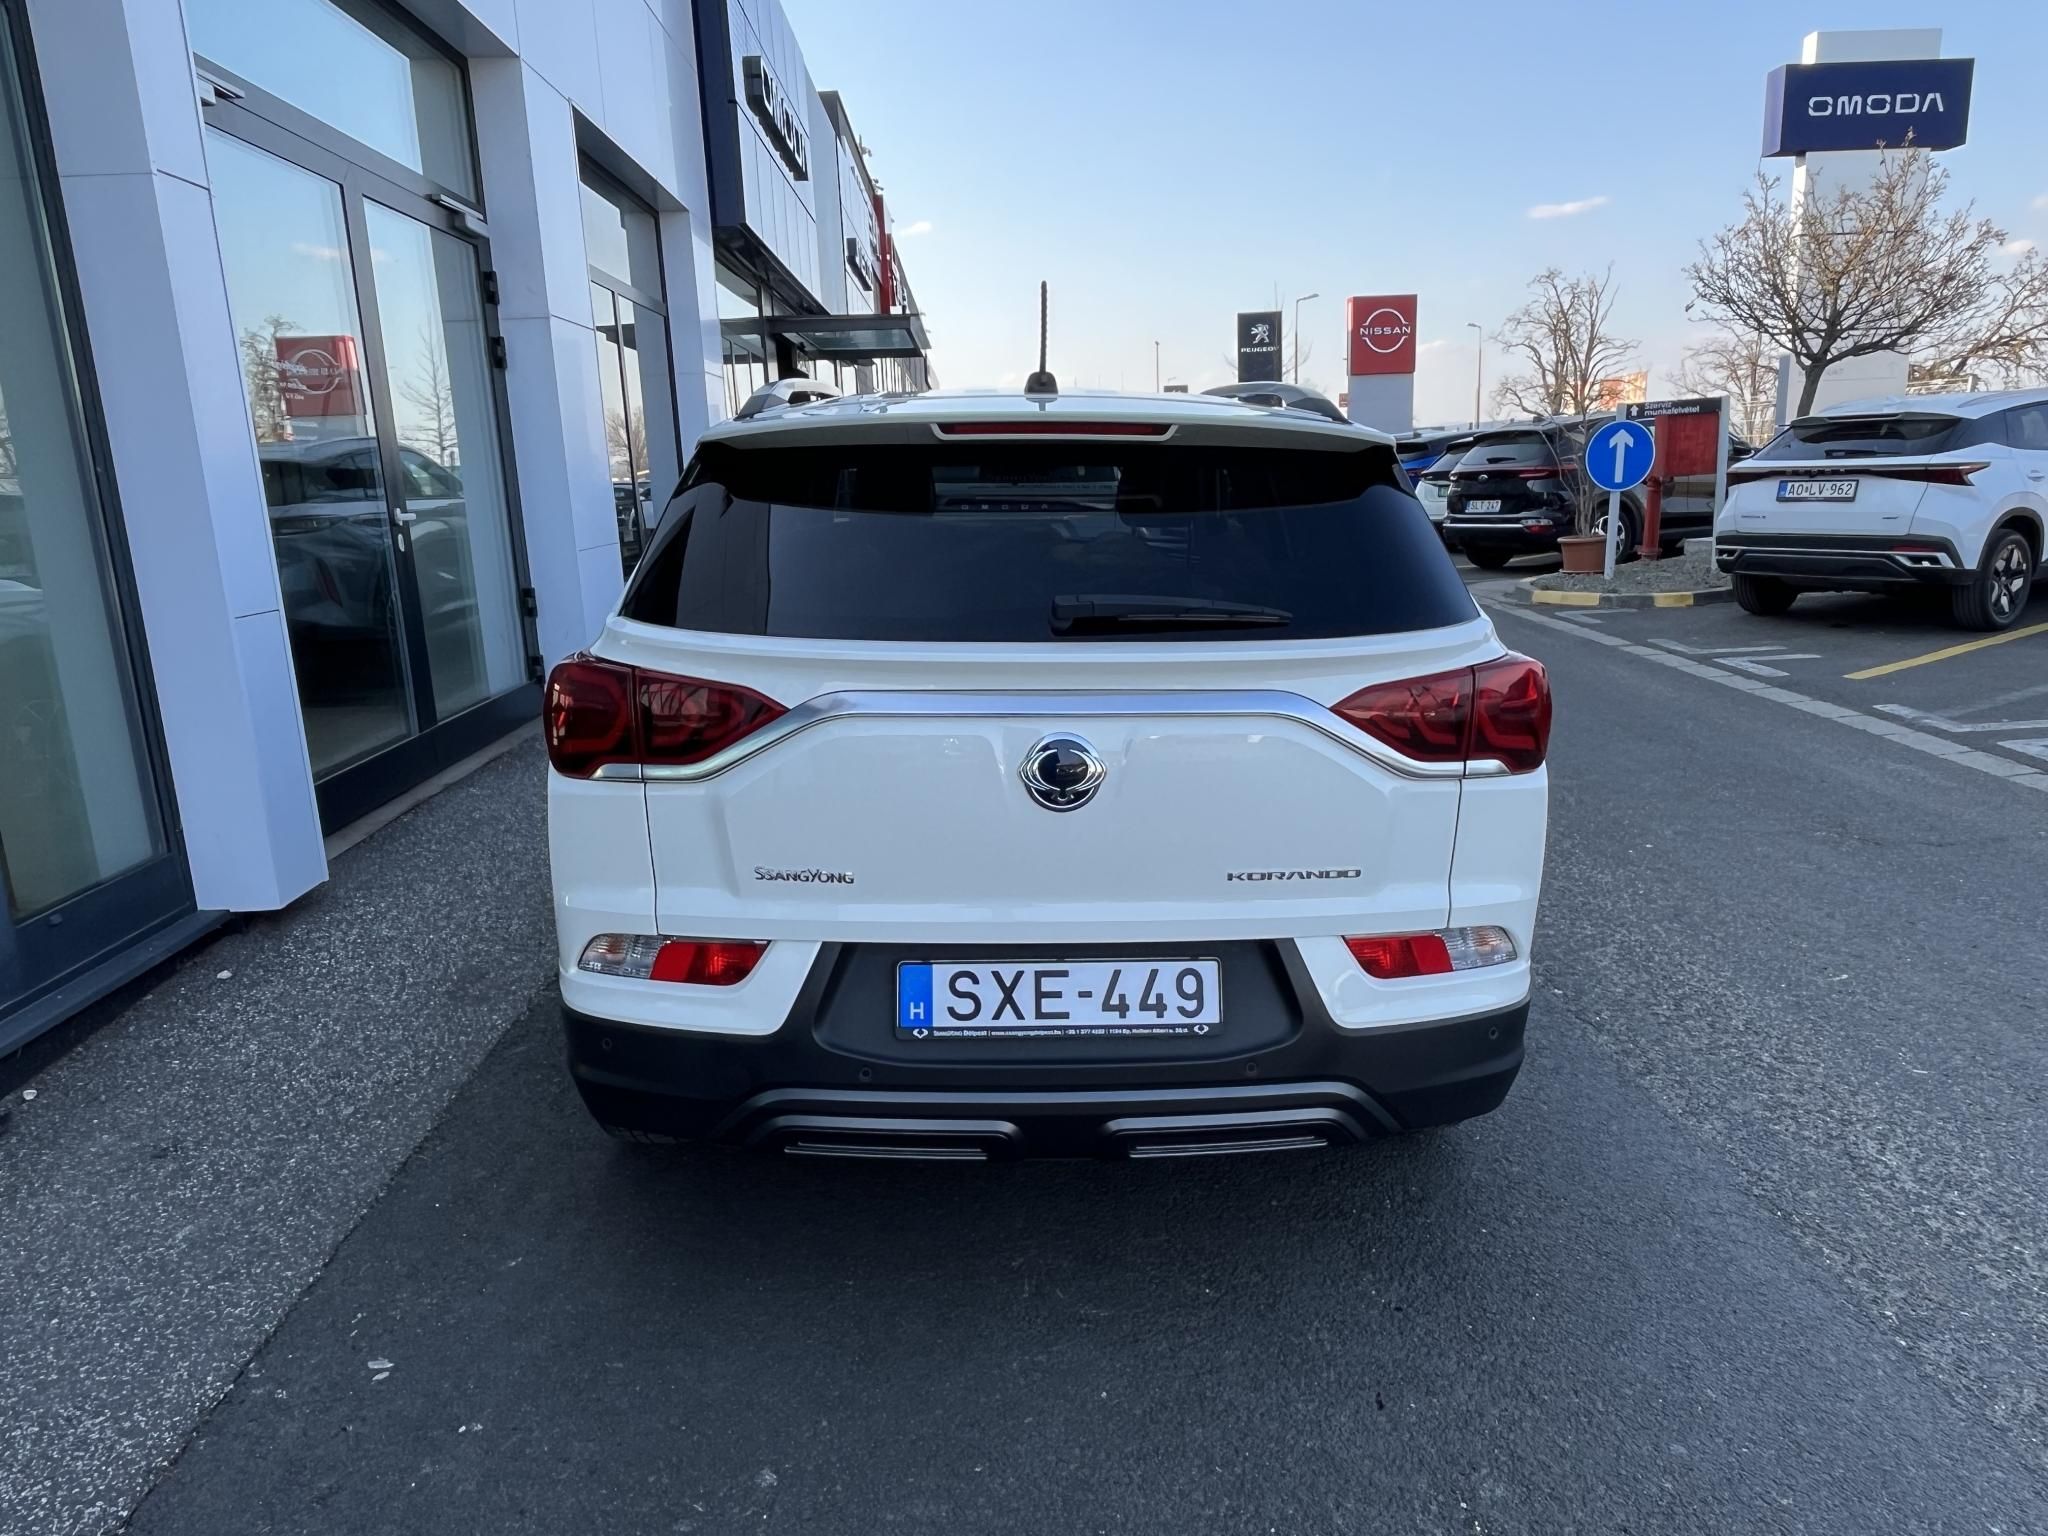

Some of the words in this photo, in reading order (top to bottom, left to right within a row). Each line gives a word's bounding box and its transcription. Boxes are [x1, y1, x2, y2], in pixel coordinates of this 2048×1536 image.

[1808, 92, 1944, 117] OMODA
[1360, 326, 1411, 336] NISSAN
[1227, 869, 1362, 882] KORANDO
[946, 967, 1205, 1022] SXE-449
[909, 1001, 925, 1020] H
